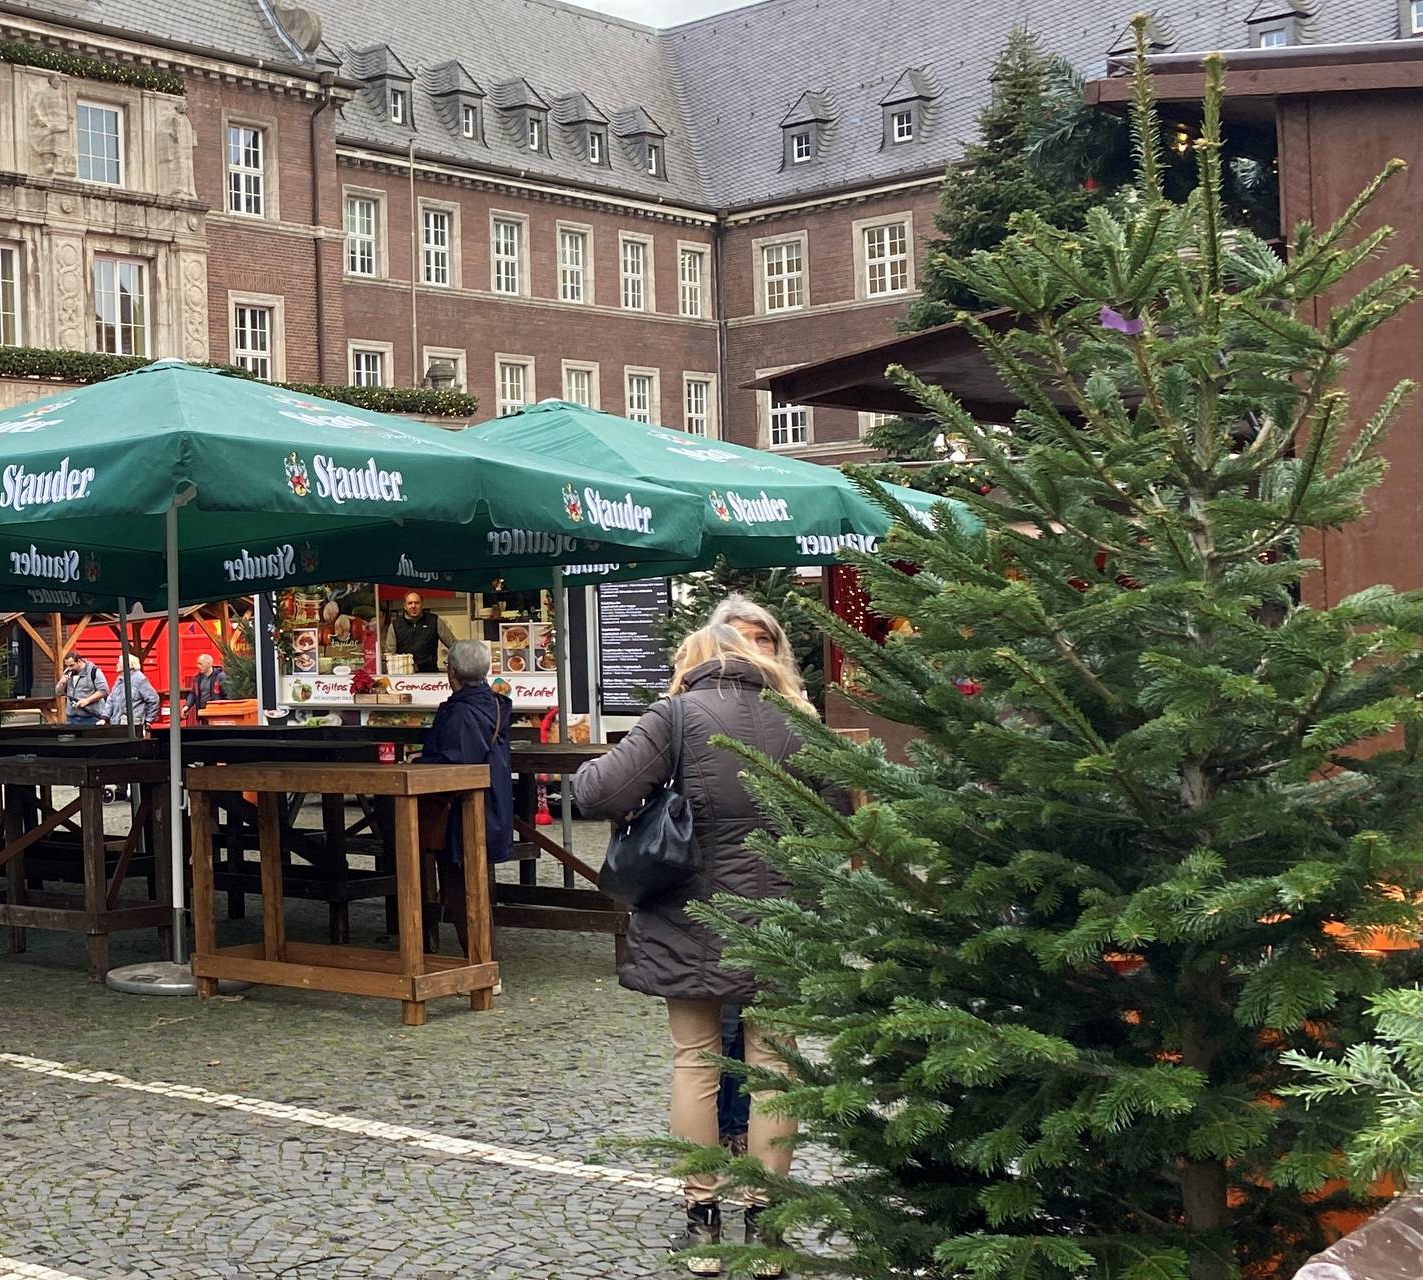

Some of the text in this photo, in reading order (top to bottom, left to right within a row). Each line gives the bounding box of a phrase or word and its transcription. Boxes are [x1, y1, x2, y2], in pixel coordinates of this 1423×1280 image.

[0, 456, 94, 511] Stauder
[313, 454, 403, 504] Stauder
[584, 487, 653, 534] Stauder
[728, 490, 791, 525] Stauder
